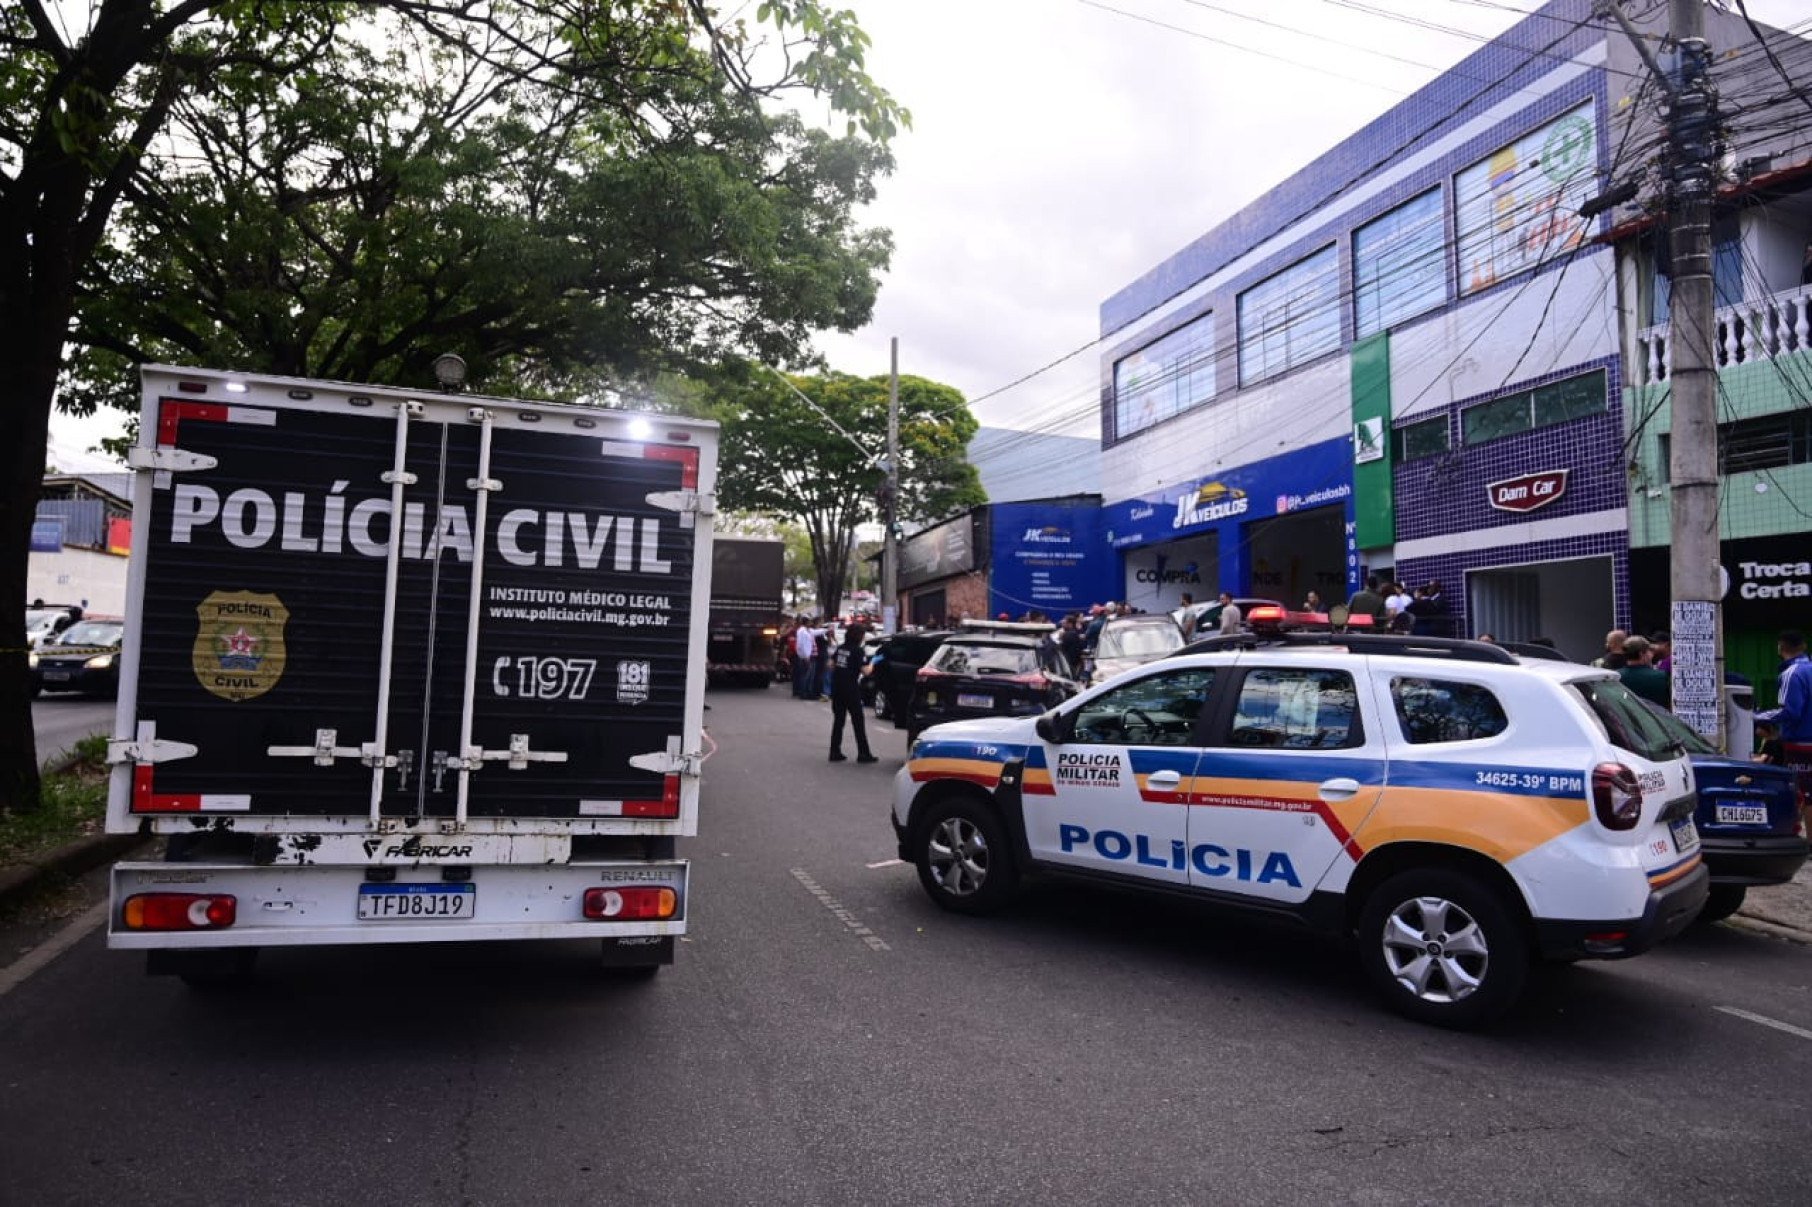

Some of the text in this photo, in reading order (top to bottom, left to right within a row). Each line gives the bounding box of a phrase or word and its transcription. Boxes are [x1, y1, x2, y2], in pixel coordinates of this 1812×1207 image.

[1498, 481, 1556, 502] Dam Car
[171, 480, 672, 574] POLÍCIA CIVIL
[1136, 569, 1200, 584] COMPRA
[1738, 562, 1811, 579] Troca
[490, 587, 671, 609] INSTITUTO MÉDICO LEGAL
[1740, 581, 1810, 599] Certa
[217, 602, 272, 618] POLÍCIA
[490, 607, 669, 626] www.policiacivil.mg.gov.br
[517, 657, 596, 699] 197
[619, 663, 648, 684] 181
[215, 677, 259, 688] CIVIL
[976, 746, 998, 756] 190
[1057, 767, 1119, 781] MILITAR
[1549, 776, 1582, 792] BPM
[385, 846, 473, 857] FABRICAR
[601, 871, 676, 881] RENAULT
[370, 895, 464, 915] TFD8J19
